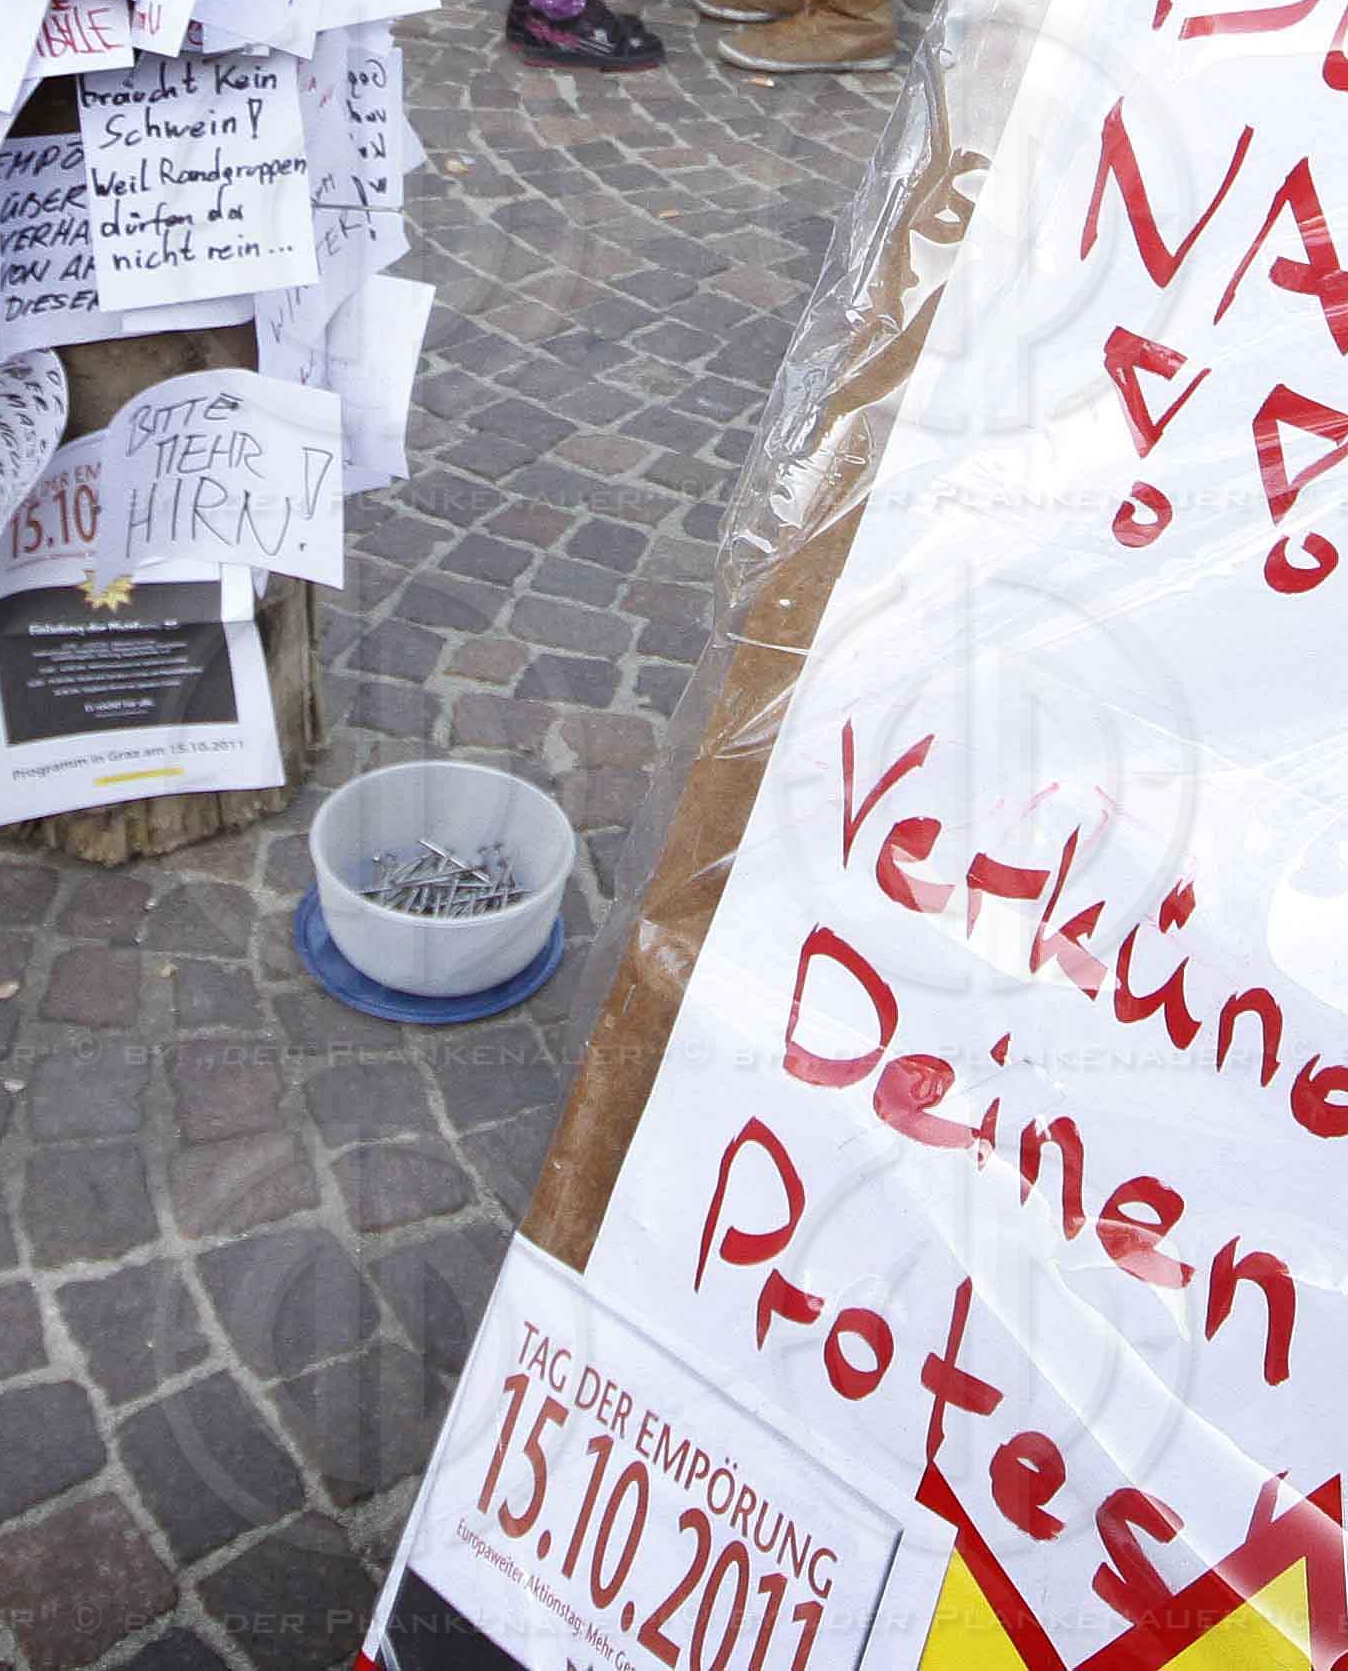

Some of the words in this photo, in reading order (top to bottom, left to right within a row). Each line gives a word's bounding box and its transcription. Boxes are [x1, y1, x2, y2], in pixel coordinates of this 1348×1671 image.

[92, 157, 151, 198] Weil
[160, 147, 308, 186] Randgruppen
[113, 228, 197, 272] nicht
[126, 392, 245, 458] BITTE
[12, 753, 90, 781] Programm
[107, 749, 141, 763] Graz
[142, 747, 165, 759] am
[782, 923, 1298, 1387] Deinen
[515, 1321, 573, 1393] TAG
[574, 1365, 633, 1440] DER
[636, 1409, 839, 1599] EMPÖRUNG
[586, 1623, 616, 1660] Mehr
